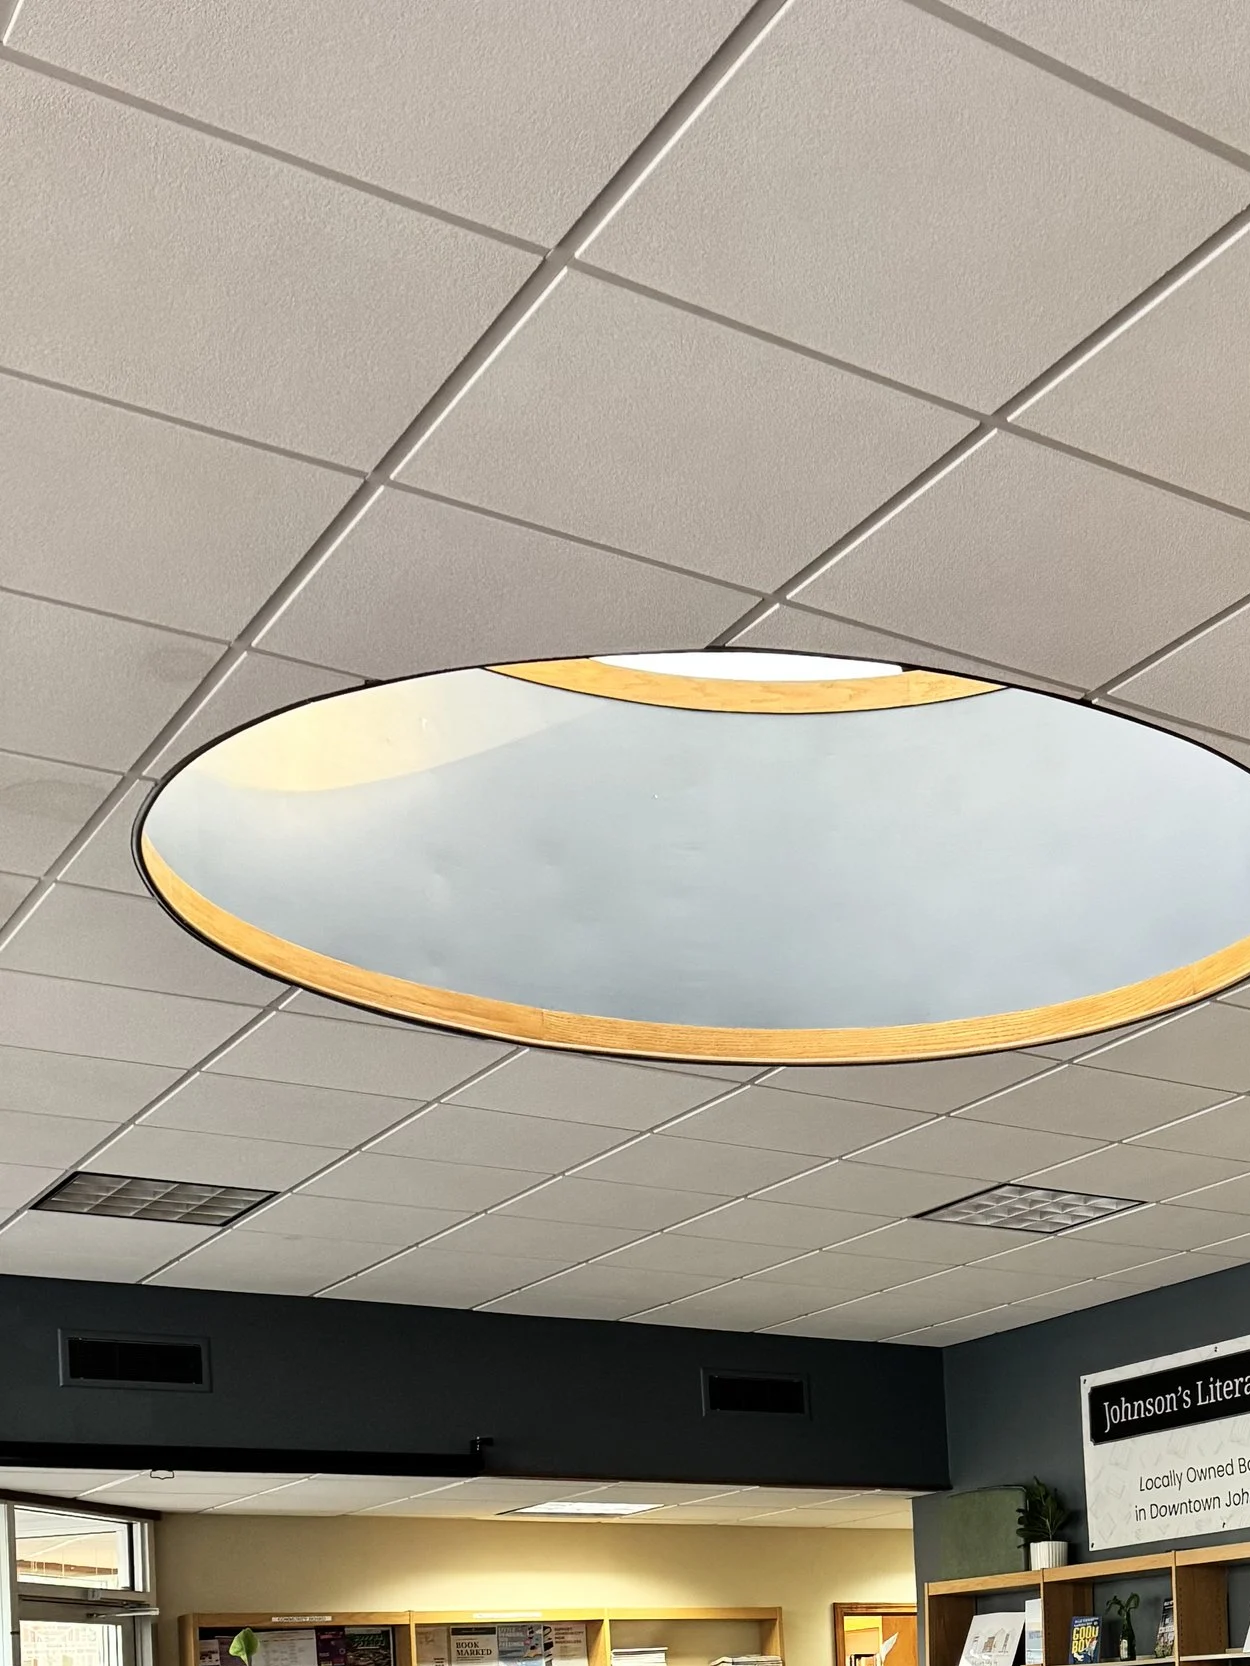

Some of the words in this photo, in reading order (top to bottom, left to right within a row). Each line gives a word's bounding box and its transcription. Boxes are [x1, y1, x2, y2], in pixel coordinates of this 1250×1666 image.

[1103, 1386, 1191, 1433] Johnson's
[1139, 1469, 1183, 1491] Locally
[1186, 1458, 1234, 1483] Owned
[1135, 1505, 1146, 1522] in
[1150, 1495, 1221, 1520] Downtown
[455, 1641, 480, 1649] BOOK
[456, 1648, 492, 1657] MARKED
